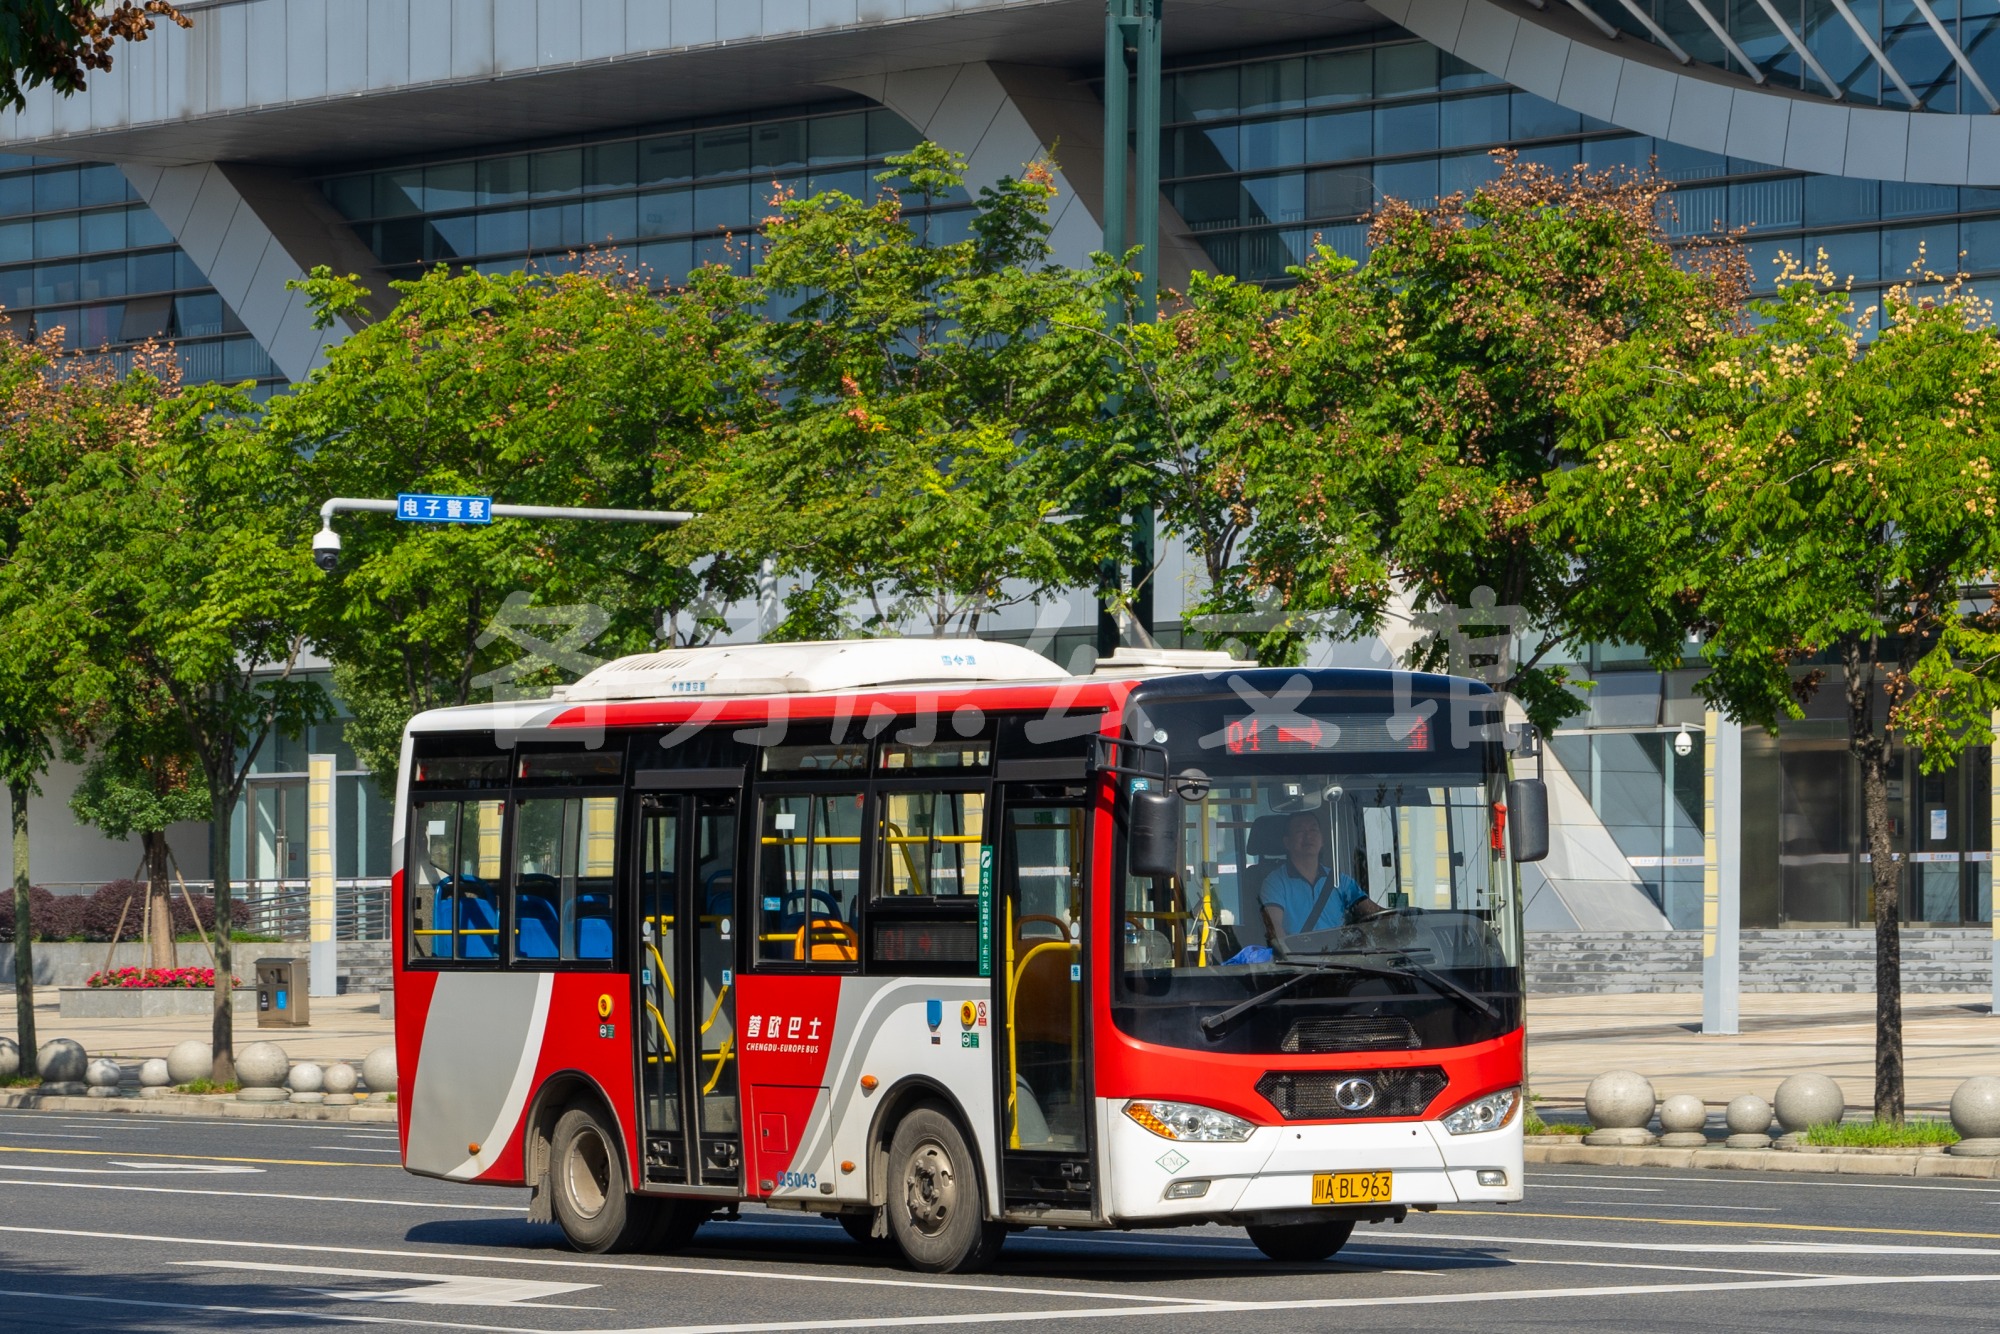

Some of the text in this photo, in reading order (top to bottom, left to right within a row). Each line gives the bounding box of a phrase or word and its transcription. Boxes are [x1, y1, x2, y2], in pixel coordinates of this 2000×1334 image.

[403, 498, 485, 519] 电子警察
[747, 1015, 822, 1040] 蓉欧巴士
[805, 1045, 819, 1054] BUS
[1162, 1157, 1183, 1167] CNG
[777, 1171, 817, 1189] Q5043
